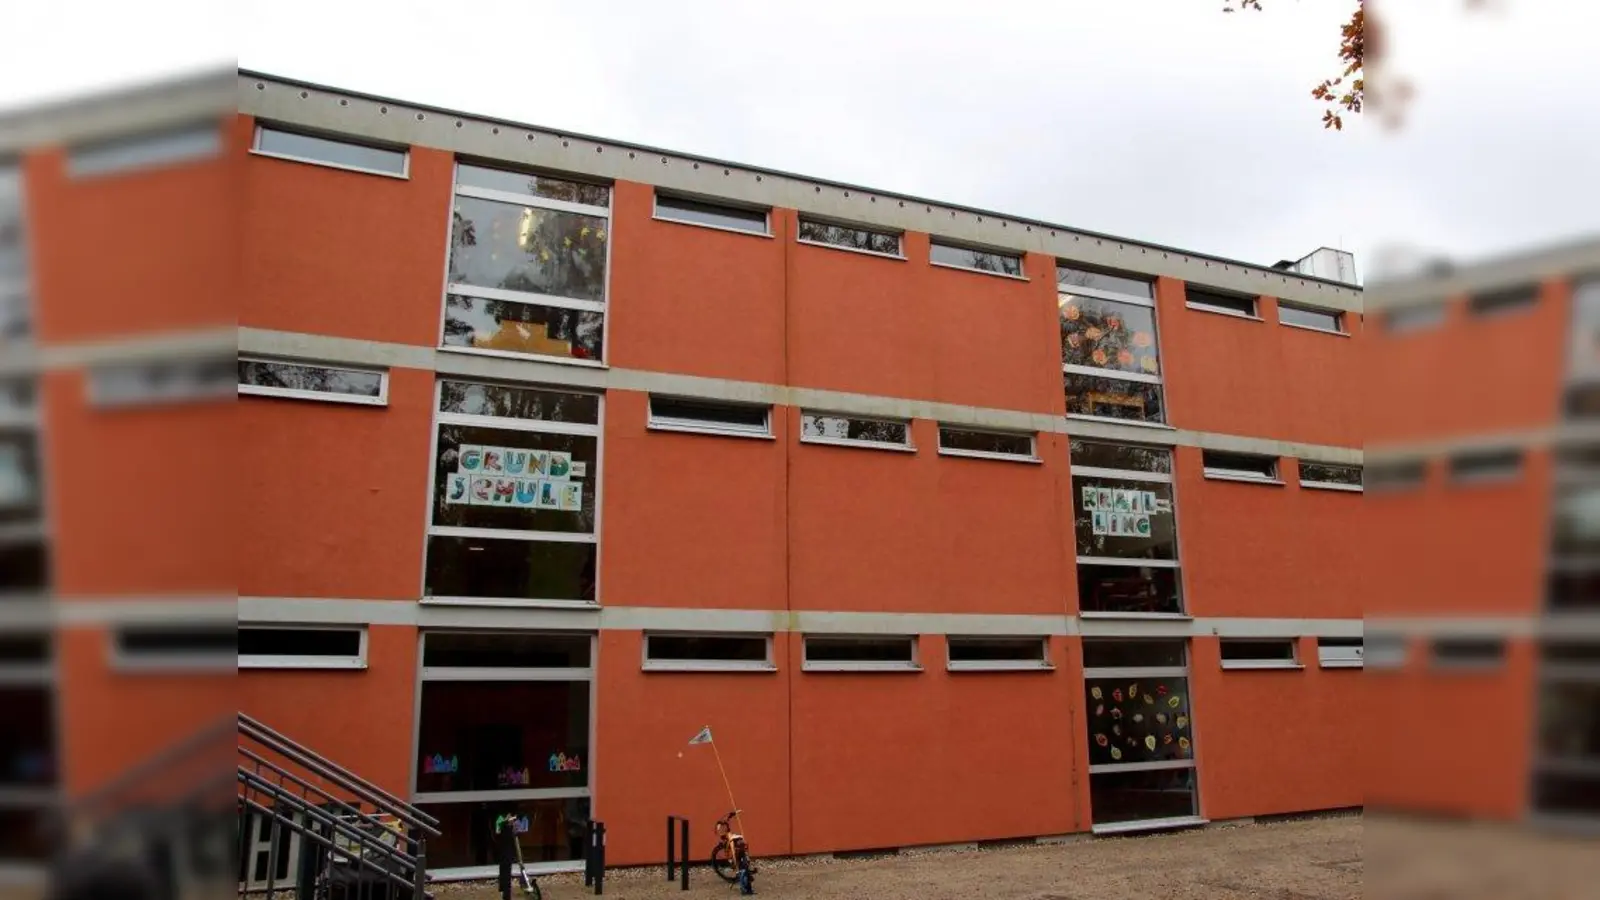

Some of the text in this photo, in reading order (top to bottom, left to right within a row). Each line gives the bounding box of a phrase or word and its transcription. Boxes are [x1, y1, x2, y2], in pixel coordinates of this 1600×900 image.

[459, 448, 585, 477] GRUND-
[450, 476, 579, 507] SCHULE
[1083, 489, 1168, 512] KRAIL-
[1094, 513, 1150, 534] LING
